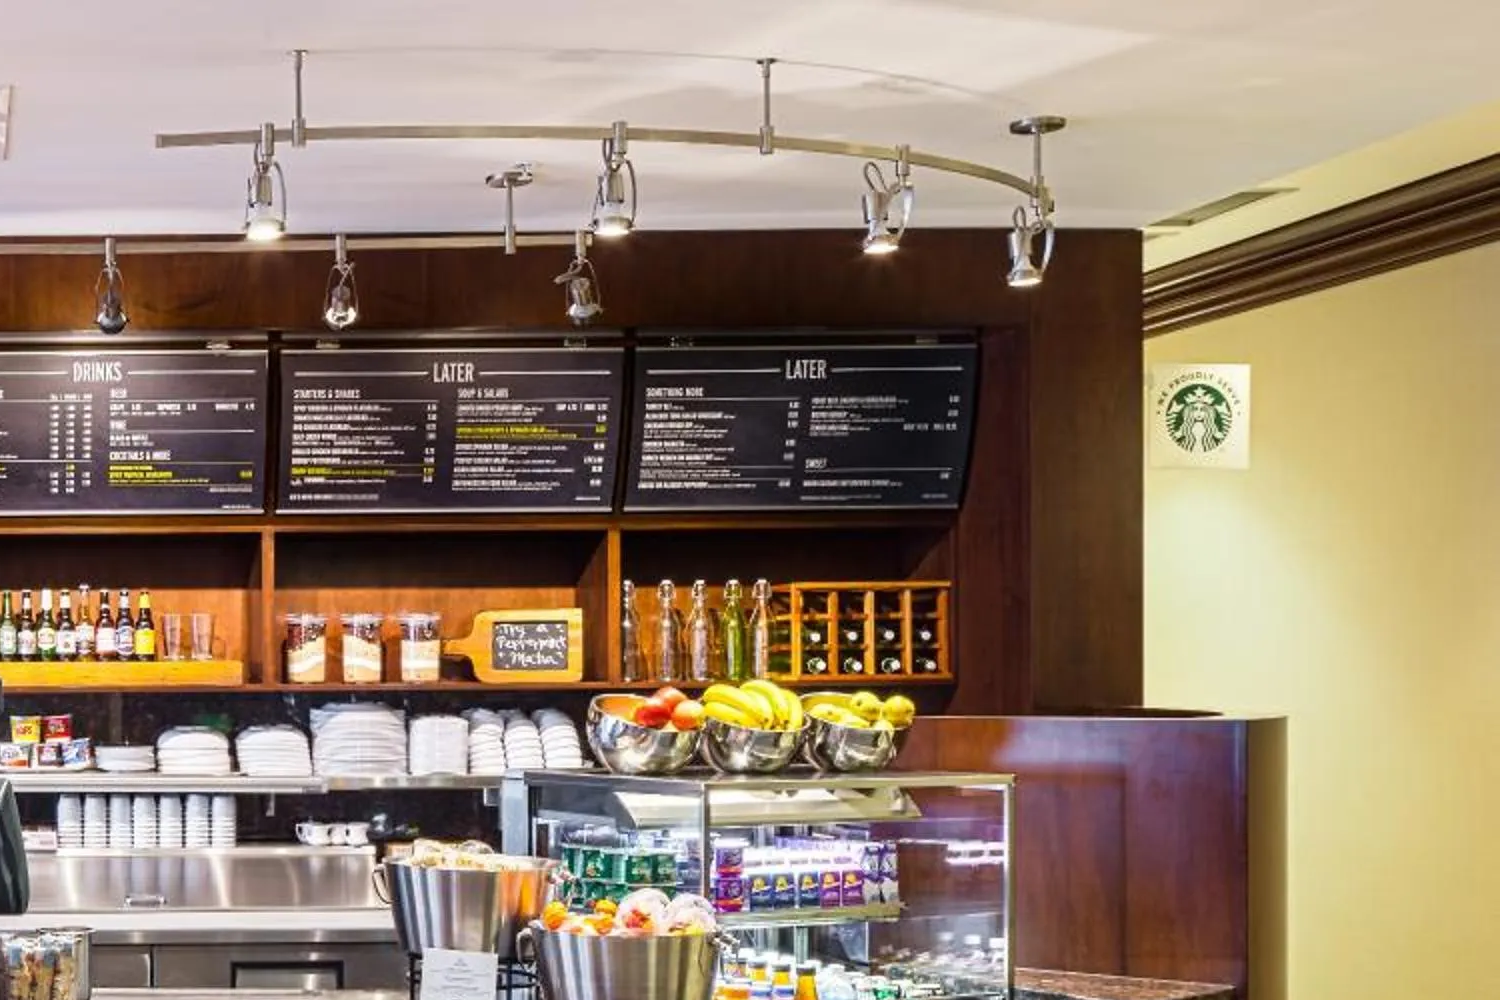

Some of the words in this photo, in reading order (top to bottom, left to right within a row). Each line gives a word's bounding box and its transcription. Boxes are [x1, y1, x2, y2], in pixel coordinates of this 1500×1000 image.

[73, 361, 122, 382] DRINKS
[433, 362, 475, 383] LATER
[785, 359, 827, 379] LATER
[1168, 371, 1214, 389] PROUDLY
